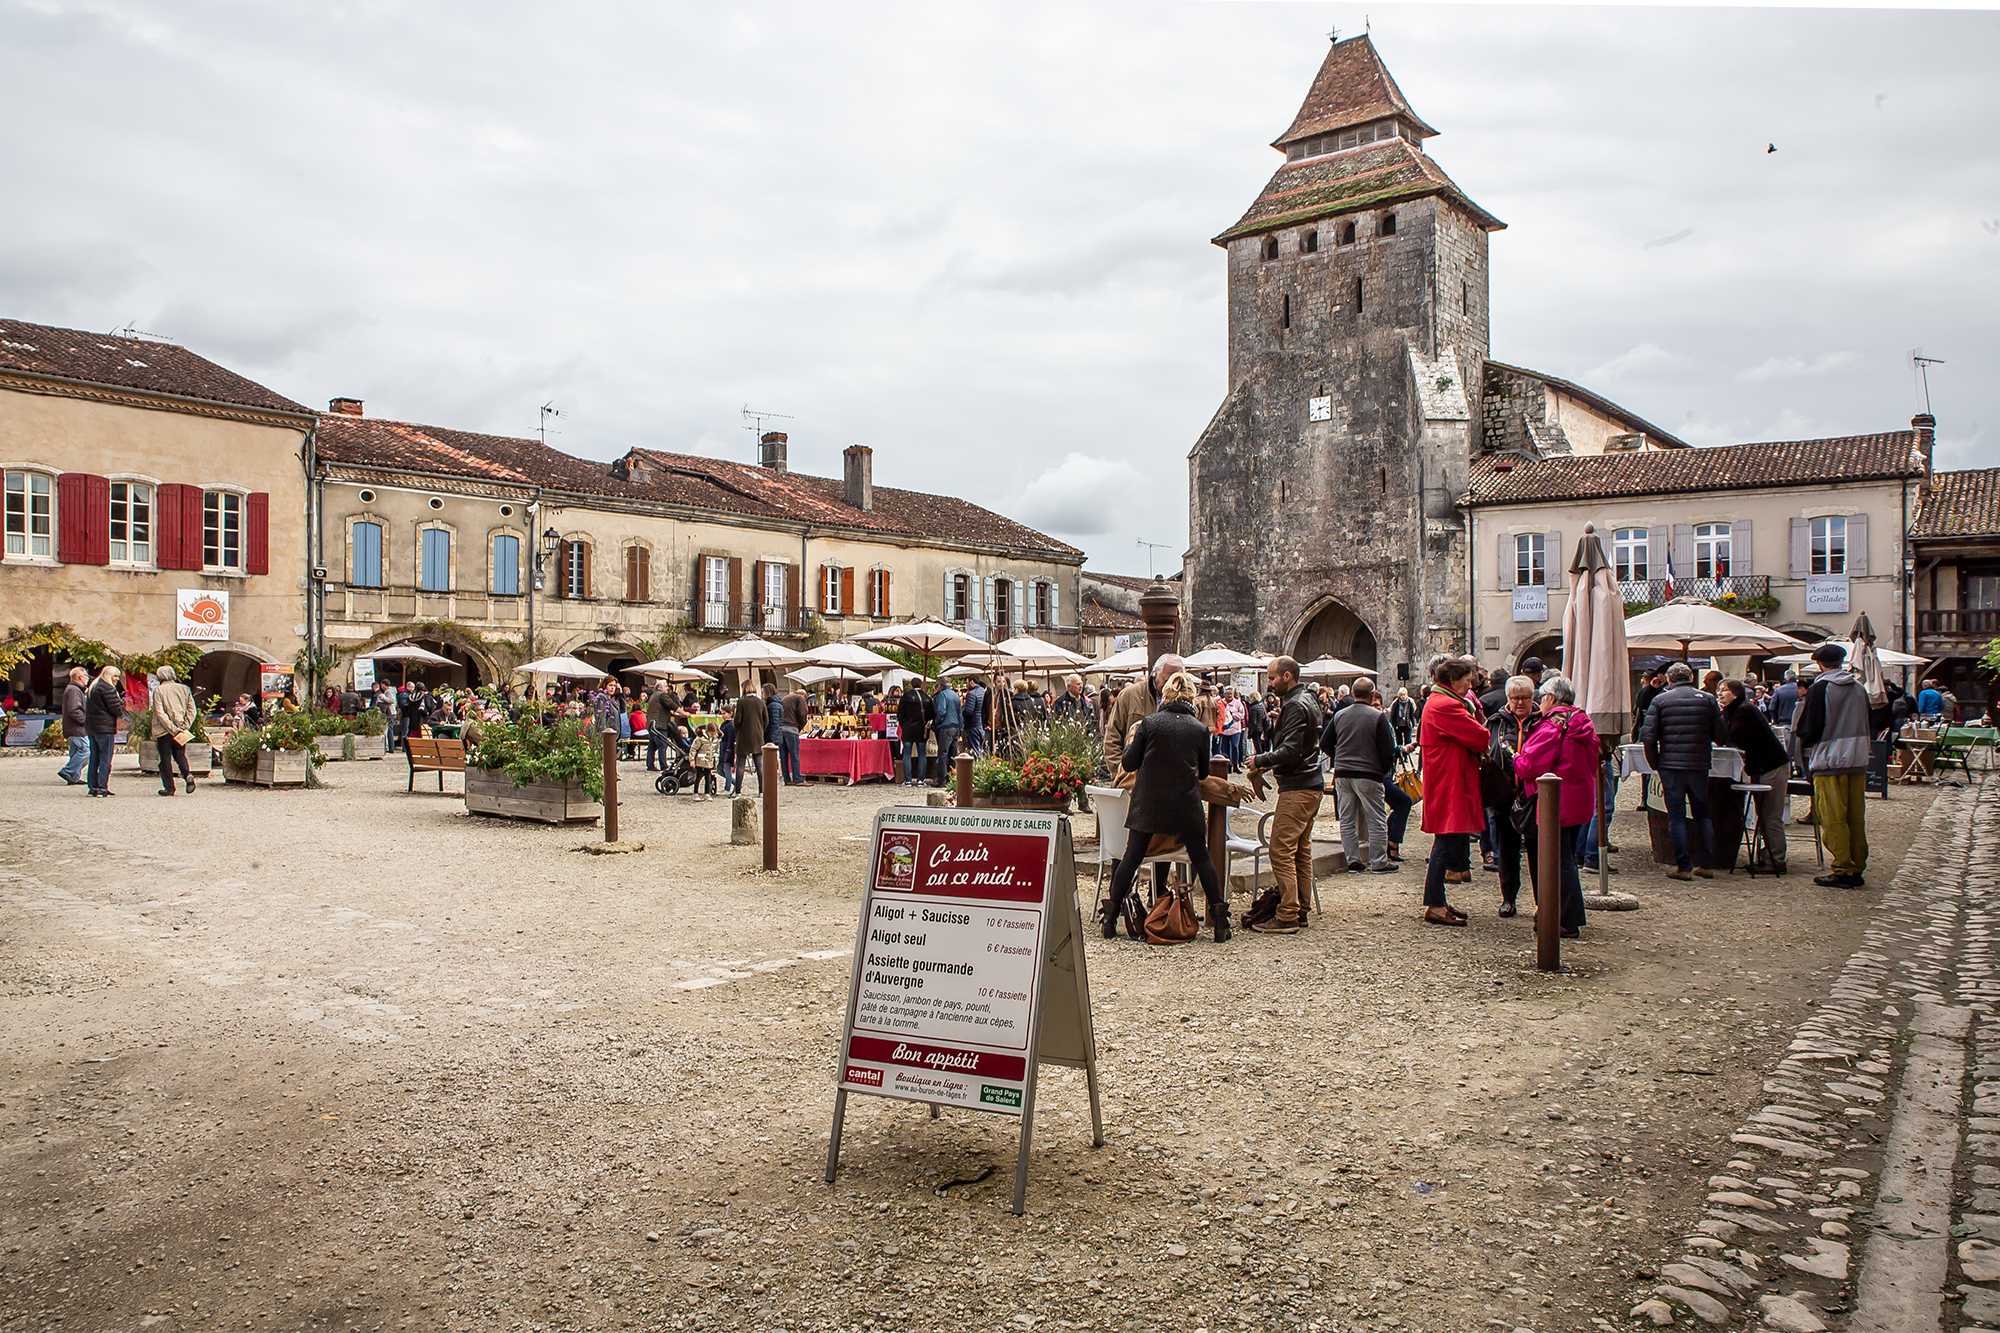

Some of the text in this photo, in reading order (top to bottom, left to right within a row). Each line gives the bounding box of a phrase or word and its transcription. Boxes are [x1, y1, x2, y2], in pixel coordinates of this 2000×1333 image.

[1809, 595, 1846, 603] Grillades
[179, 624, 228, 638] cittaslow
[881, 813, 1052, 830] SITE REMARQUABLE DU GOÛT DU PAYS DE SALERS
[929, 842, 989, 868] Ce soir
[926, 871, 948, 886] ou
[951, 872, 969, 885] ce
[972, 866, 1015, 886] midi
[874, 905, 970, 925] Aligot + Saucisse
[986, 918, 1035, 930] 10 € l'assiette
[871, 929, 926, 946] Aligot seul
[987, 943, 1032, 956] 6 € l'assiette
[867, 953, 974, 975] Assiette gourmande
[866, 971, 924, 989] d'Auvergne
[863, 989, 992, 1013] Saucisson, jambon de pays, pounti,
[978, 988, 1027, 1001] 10 € l'assiette
[860, 1014, 920, 1029] tarte à la tomme.
[861, 1002, 1015, 1029] pâté de campagne à l'ancienne aux cèpes,
[892, 1043, 979, 1070] Bon appétit
[848, 1069, 881, 1081] cantal
[896, 1072, 931, 1087] Boutique
[983, 1086, 1020, 1098] Grand Pays
[995, 1096, 1015, 1105] Salers
